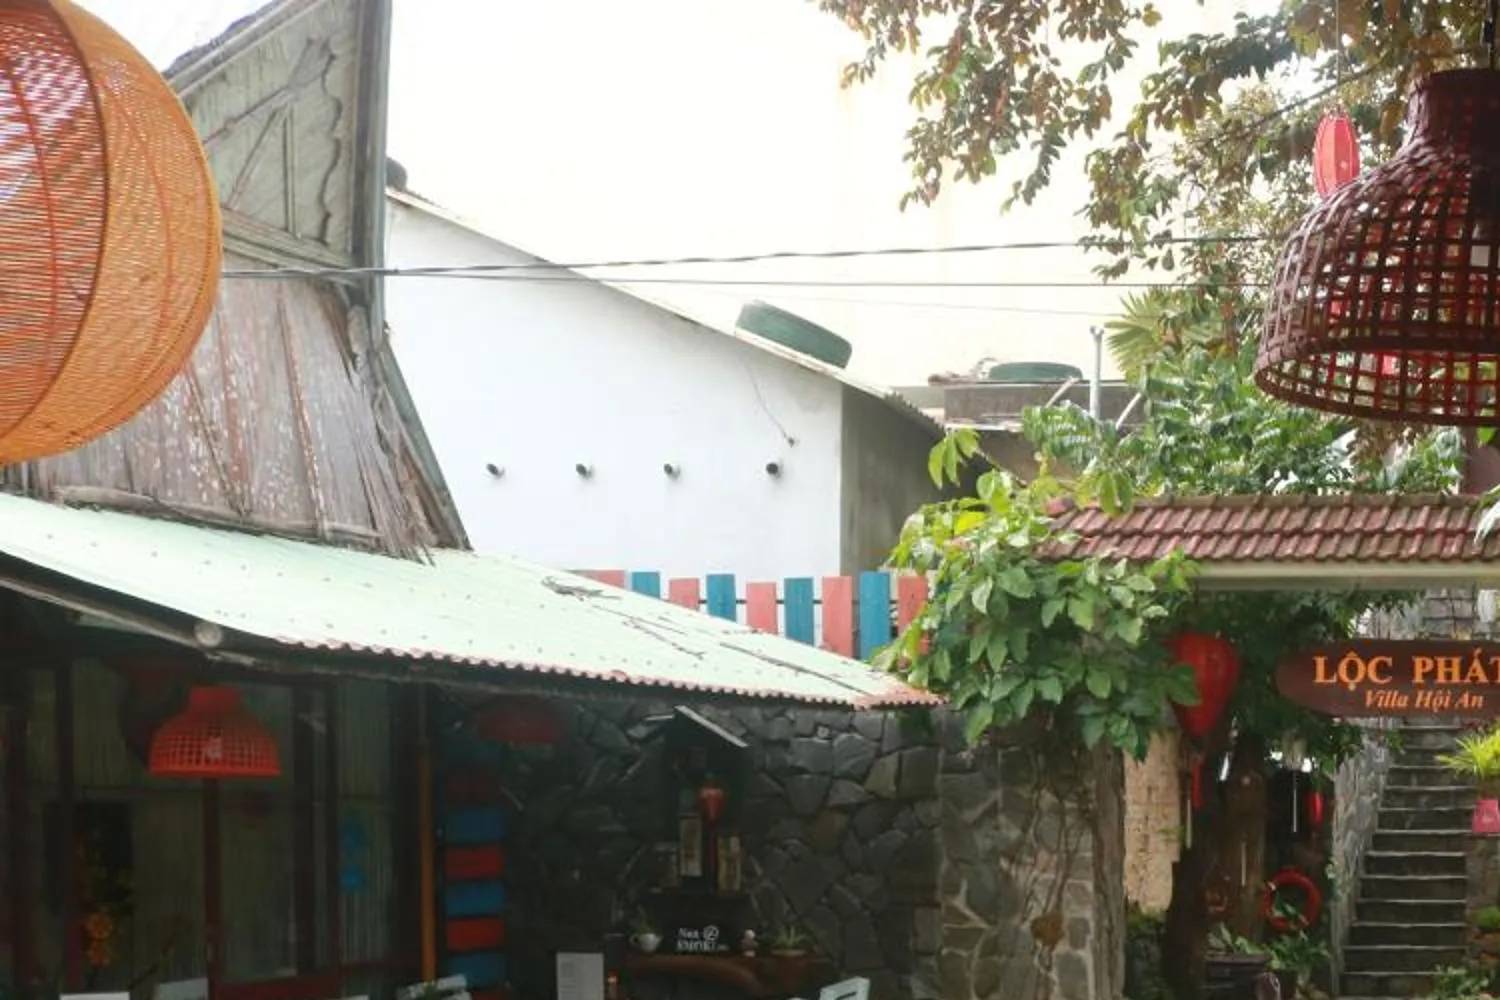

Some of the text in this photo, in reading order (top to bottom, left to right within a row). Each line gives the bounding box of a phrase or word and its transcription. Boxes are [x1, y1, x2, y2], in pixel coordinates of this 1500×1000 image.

[1312, 651, 1393, 692] LỘC
[1365, 690, 1408, 709] Villa
[1454, 690, 1485, 709] An
